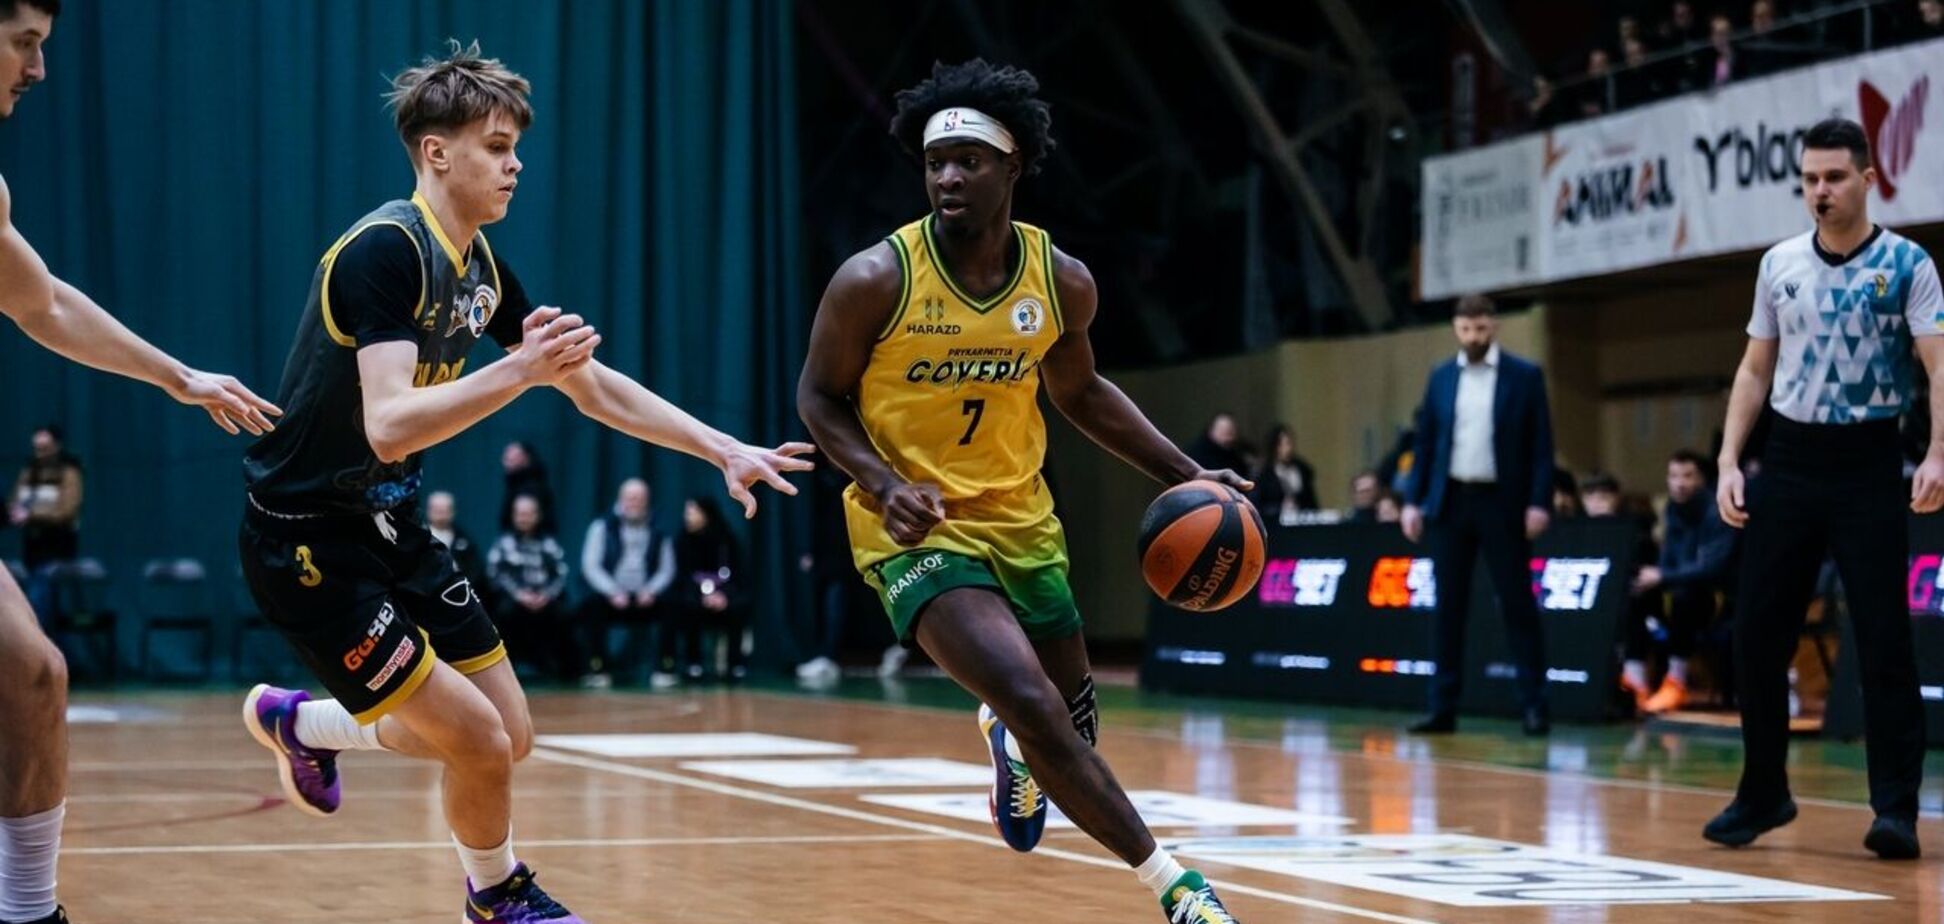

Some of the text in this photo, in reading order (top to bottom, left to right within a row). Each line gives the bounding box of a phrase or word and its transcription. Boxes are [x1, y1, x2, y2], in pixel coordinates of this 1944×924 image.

[906, 324, 961, 335] HARAZD
[948, 348, 1012, 357] PRYKARPATTIA
[958, 399, 986, 446] 7
[296, 546, 322, 587] 3
